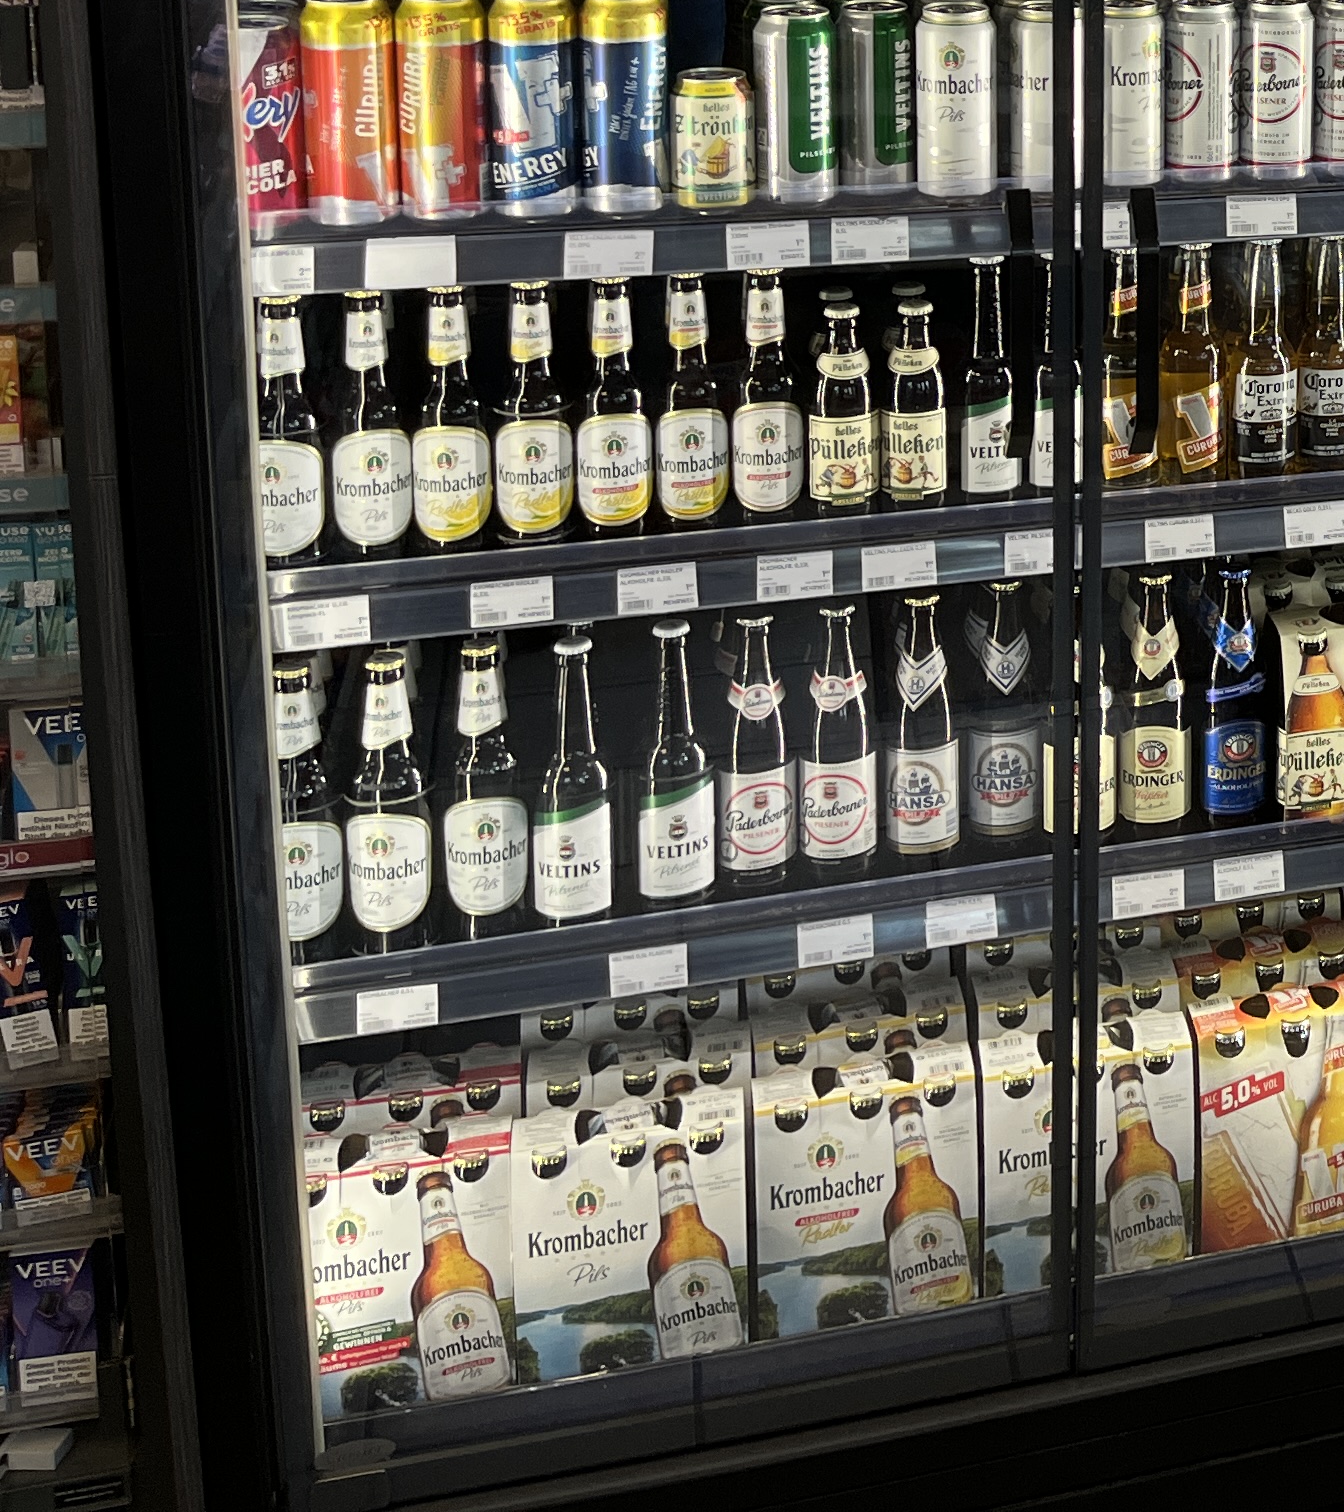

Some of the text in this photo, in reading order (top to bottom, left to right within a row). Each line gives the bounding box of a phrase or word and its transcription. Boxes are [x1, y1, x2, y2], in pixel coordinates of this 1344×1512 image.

[417, 22, 461, 36] GRATIS
[515, 19, 558, 36] GRATIS
[810, 44, 829, 141] VELTINS
[894, 39, 911, 133] VELTINS
[937, 104, 965, 124] Pils
[492, 148, 568, 184] ENERGY
[248, 170, 297, 195] COLA
[657, 447, 727, 473] Krombacher
[734, 443, 803, 466] Krombacher
[498, 464, 572, 485] Krombacher
[579, 458, 651, 479] Krombacher
[335, 472, 411, 497] Krombacher
[1306, 736, 1331, 748] helles
[976, 773, 1036, 791] HANSA
[1122, 770, 1184, 787] ERDINGER
[1207, 765, 1266, 781] ERDINGER
[888, 792, 946, 811] HANSA
[814, 819, 849, 829] PILSENER
[647, 834, 709, 860] VELTINS
[538, 860, 601, 879] VELTINS
[1203, 1095, 1218, 1107] ALC
[1263, 1078, 1278, 1090] VOL
[6, 1134, 78, 1162] VEEV
[769, 1170, 885, 1211] Krombacher
[1300, 1195, 1344, 1217] CURUBA
[528, 1220, 648, 1259] Krombacher
[800, 1220, 855, 1246] Radler
[15, 1256, 85, 1280] VEEV
[567, 1262, 611, 1287] Pils
[332, 1333, 383, 1351] GEWINNEN
